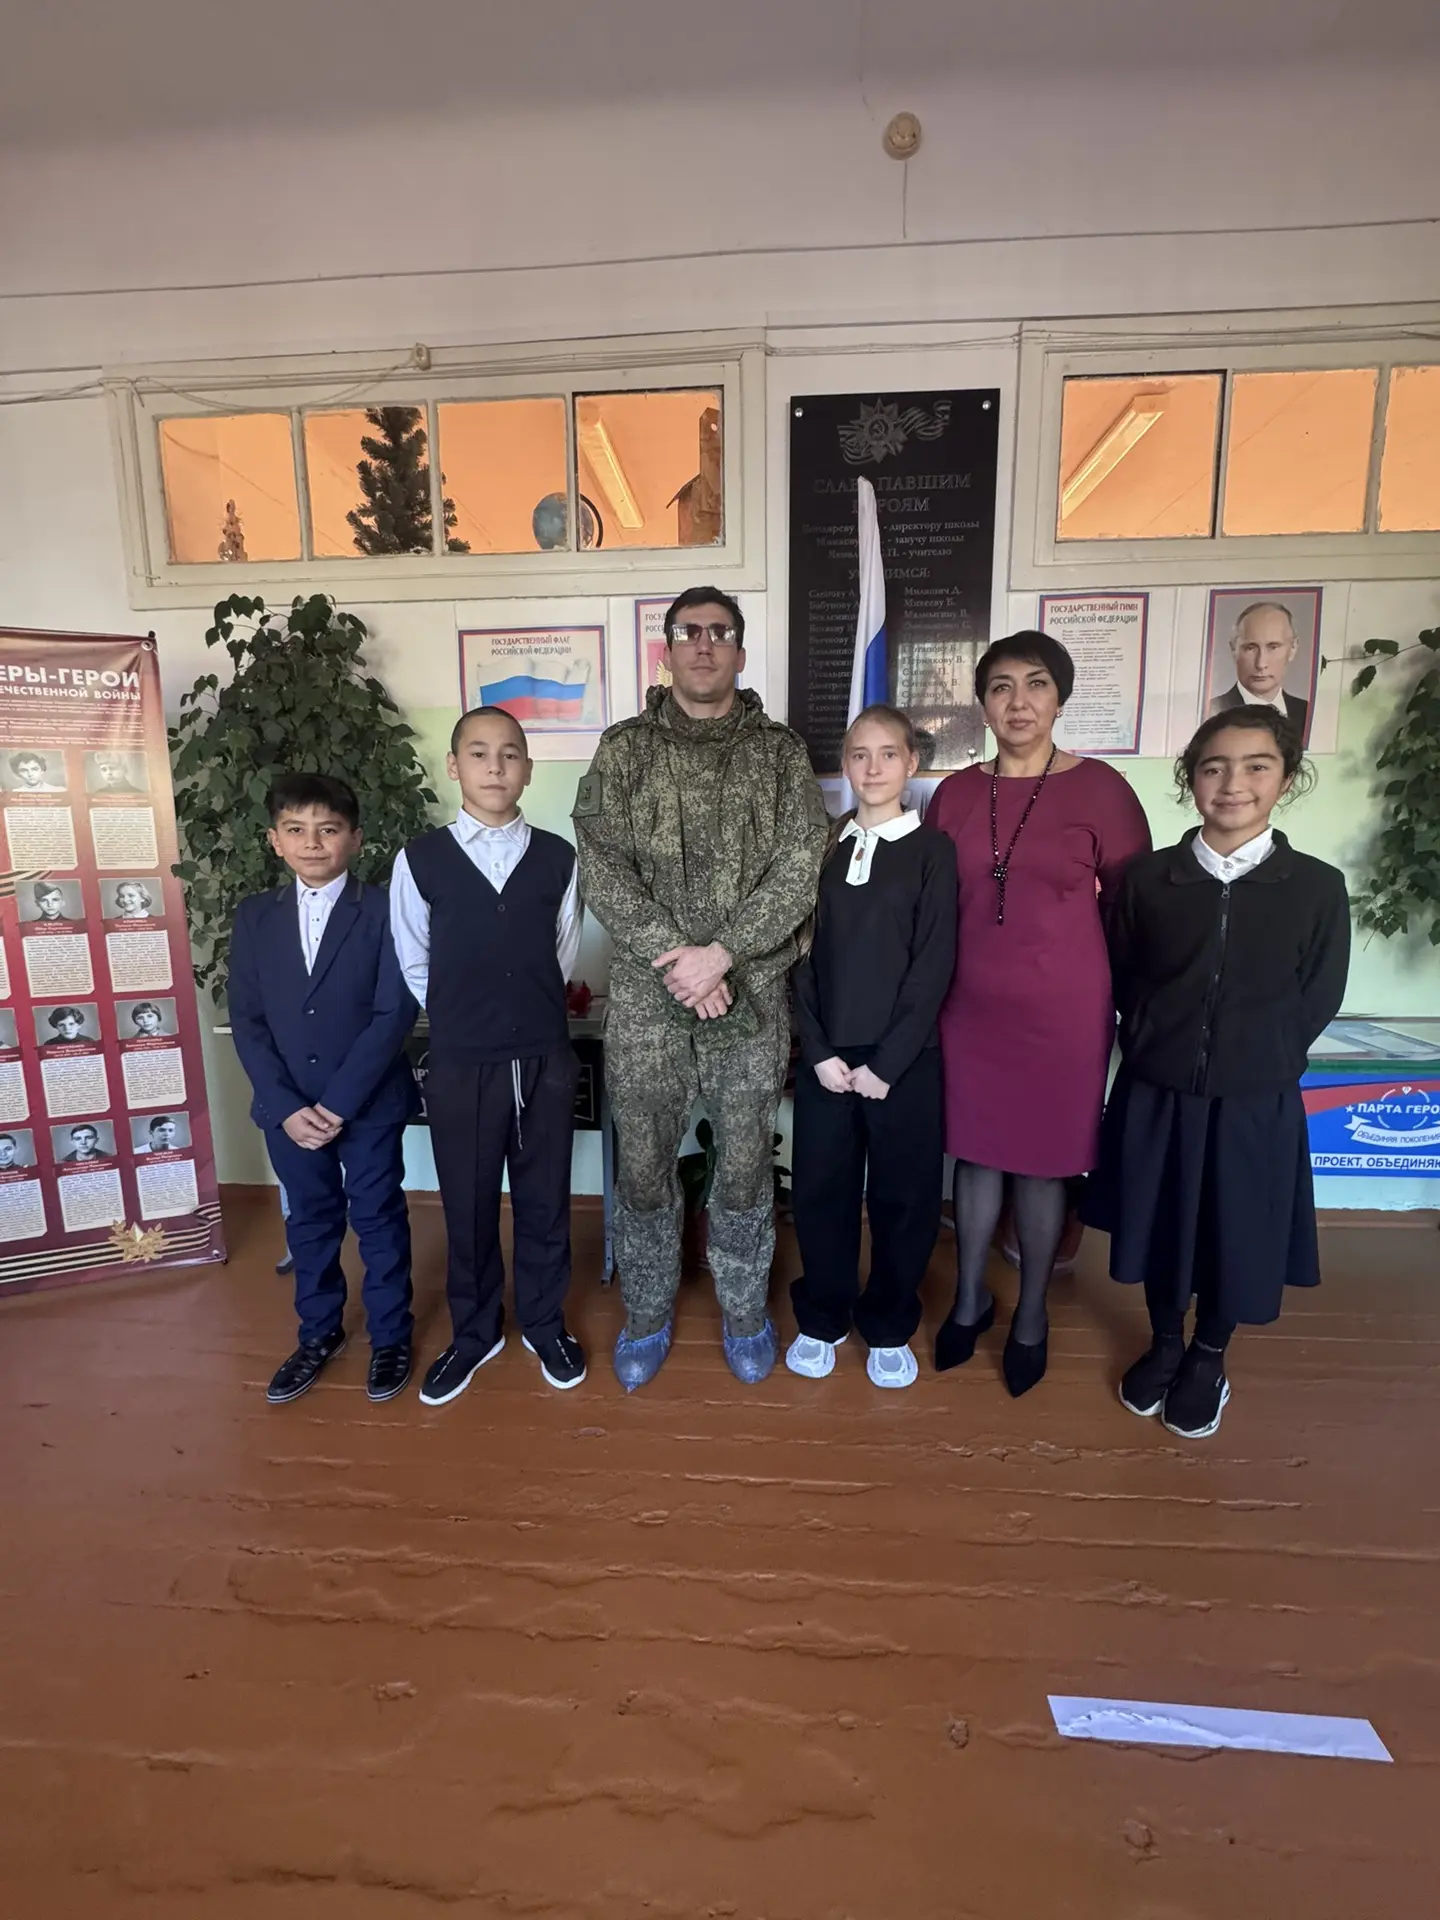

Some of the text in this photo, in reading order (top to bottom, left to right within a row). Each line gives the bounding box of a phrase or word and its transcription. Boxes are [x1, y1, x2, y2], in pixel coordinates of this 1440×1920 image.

[812, 474, 972, 494] СЛАВ ПАВШИМ
[852, 498, 930, 514] ГРОЯМ
[889, 523, 943, 533] директору
[944, 520, 980, 530] школы
[929, 534, 965, 544] школы
[908, 548, 952, 559] учителю
[848, 567, 931, 580] УИМСЯ:
[1050, 601, 1138, 613] ГОСУДАРСТВЕННЫЙ ГИМН
[1049, 613, 1138, 625] РОССИЙСКОЙ ФЕДЕРАЦИИ
[491, 635, 571, 646] ГОСУДАРСТВЕННЫЙ ФЛАГ
[491, 645, 572, 656] РОССИЙСКОЙ ФЕДЕРАЦИИ
[93, 688, 141, 701] ВОЙНЫ
[1357, 1103, 1402, 1114] ПАРТА
[1314, 1155, 1363, 1169] ПРОЕКТ,
